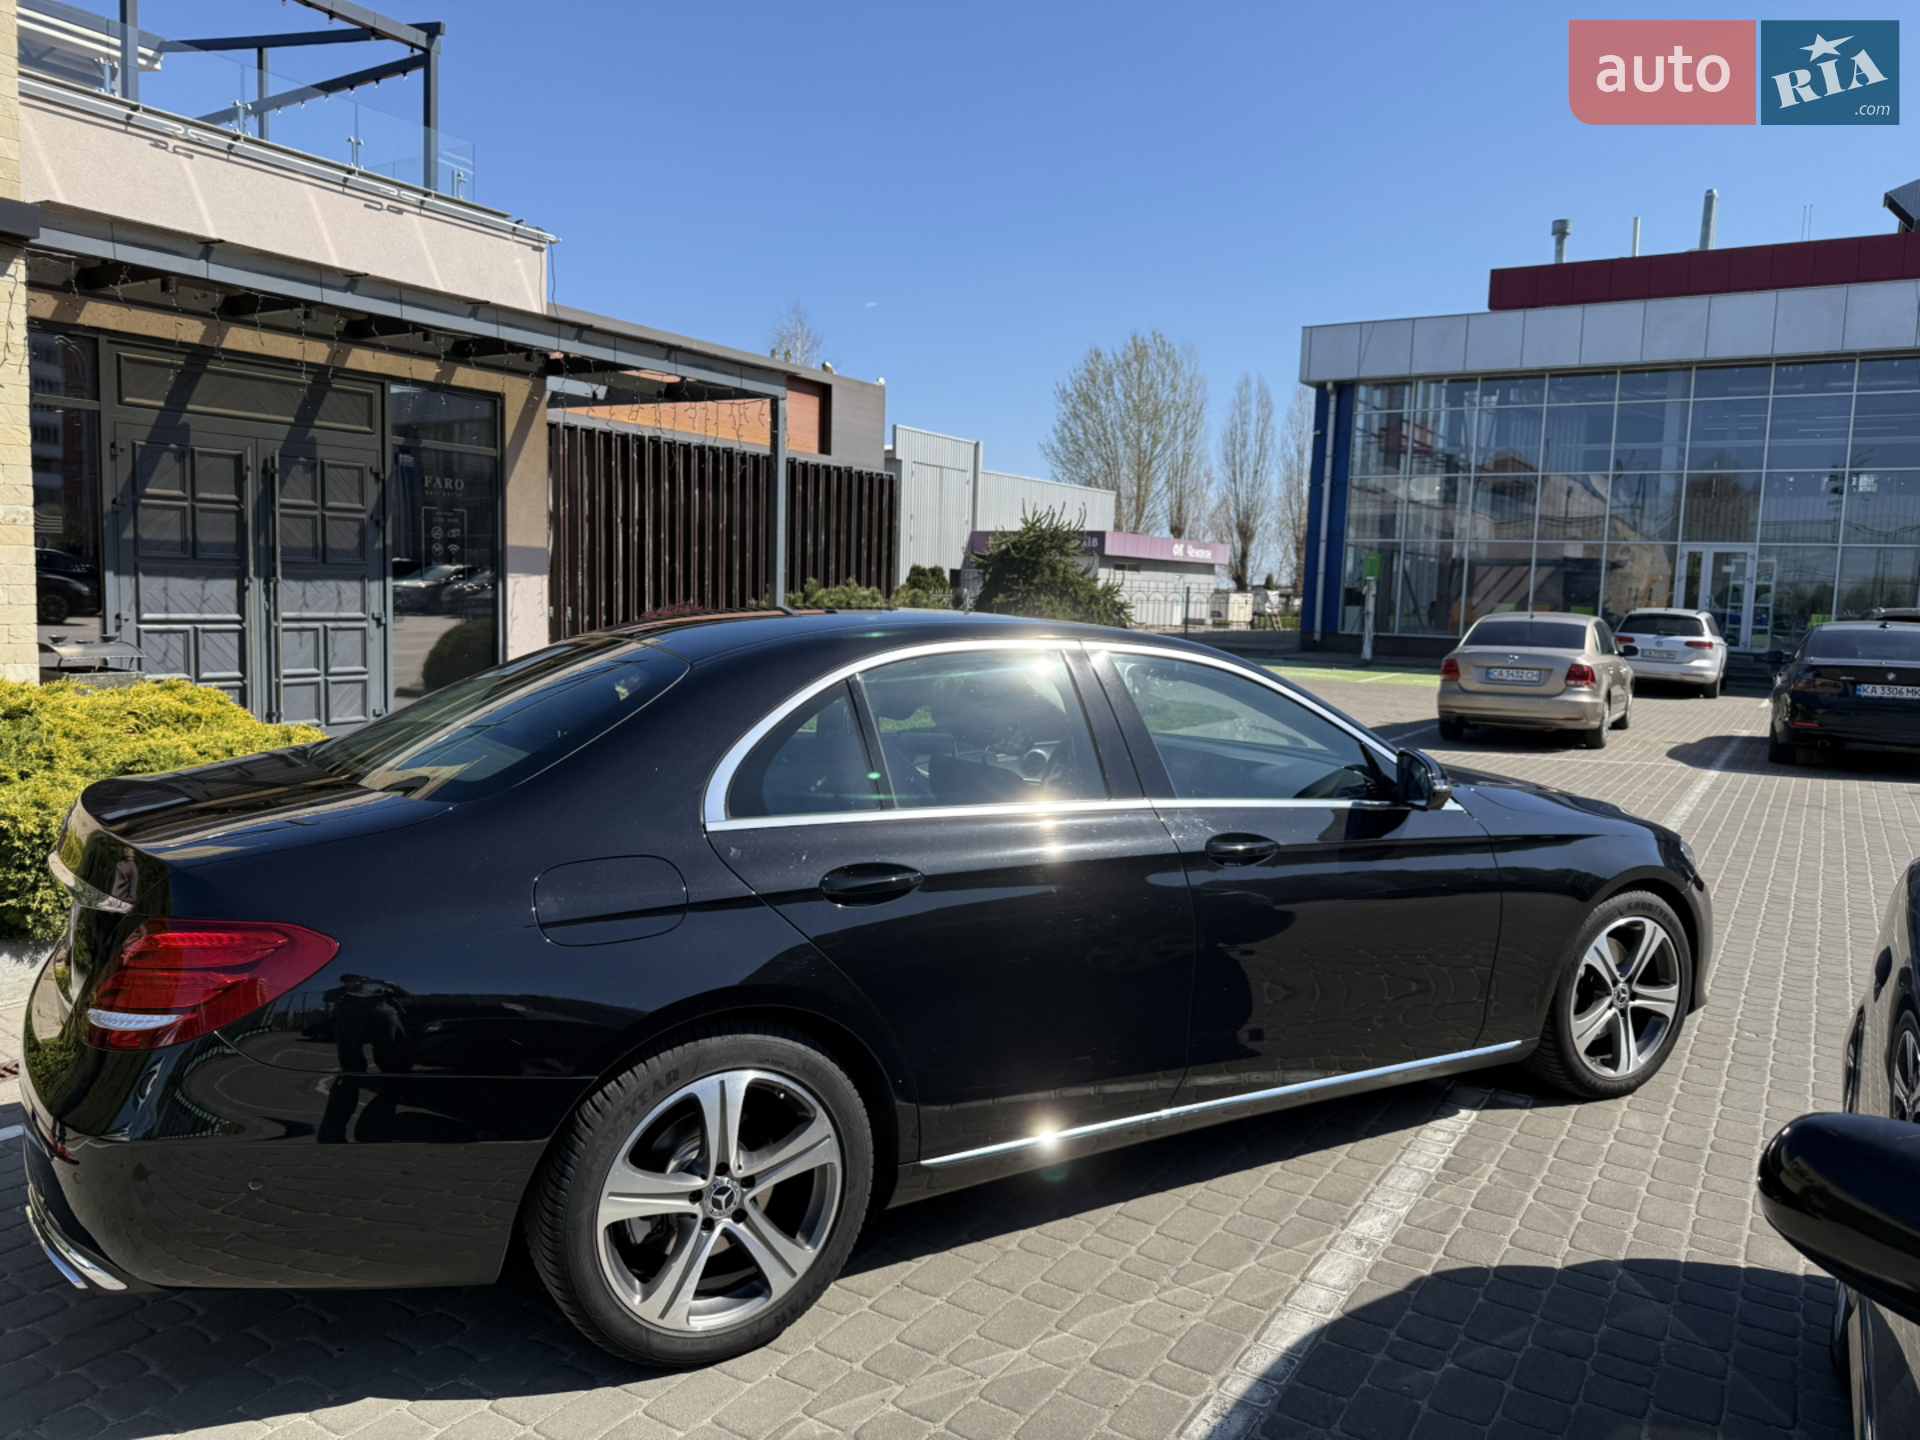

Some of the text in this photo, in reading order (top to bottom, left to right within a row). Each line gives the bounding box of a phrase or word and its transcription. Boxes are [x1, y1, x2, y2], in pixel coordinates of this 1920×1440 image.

[424, 475, 465, 490] FARO
[1862, 685, 1877, 694] KA
[1879, 686, 1905, 696] 3306
